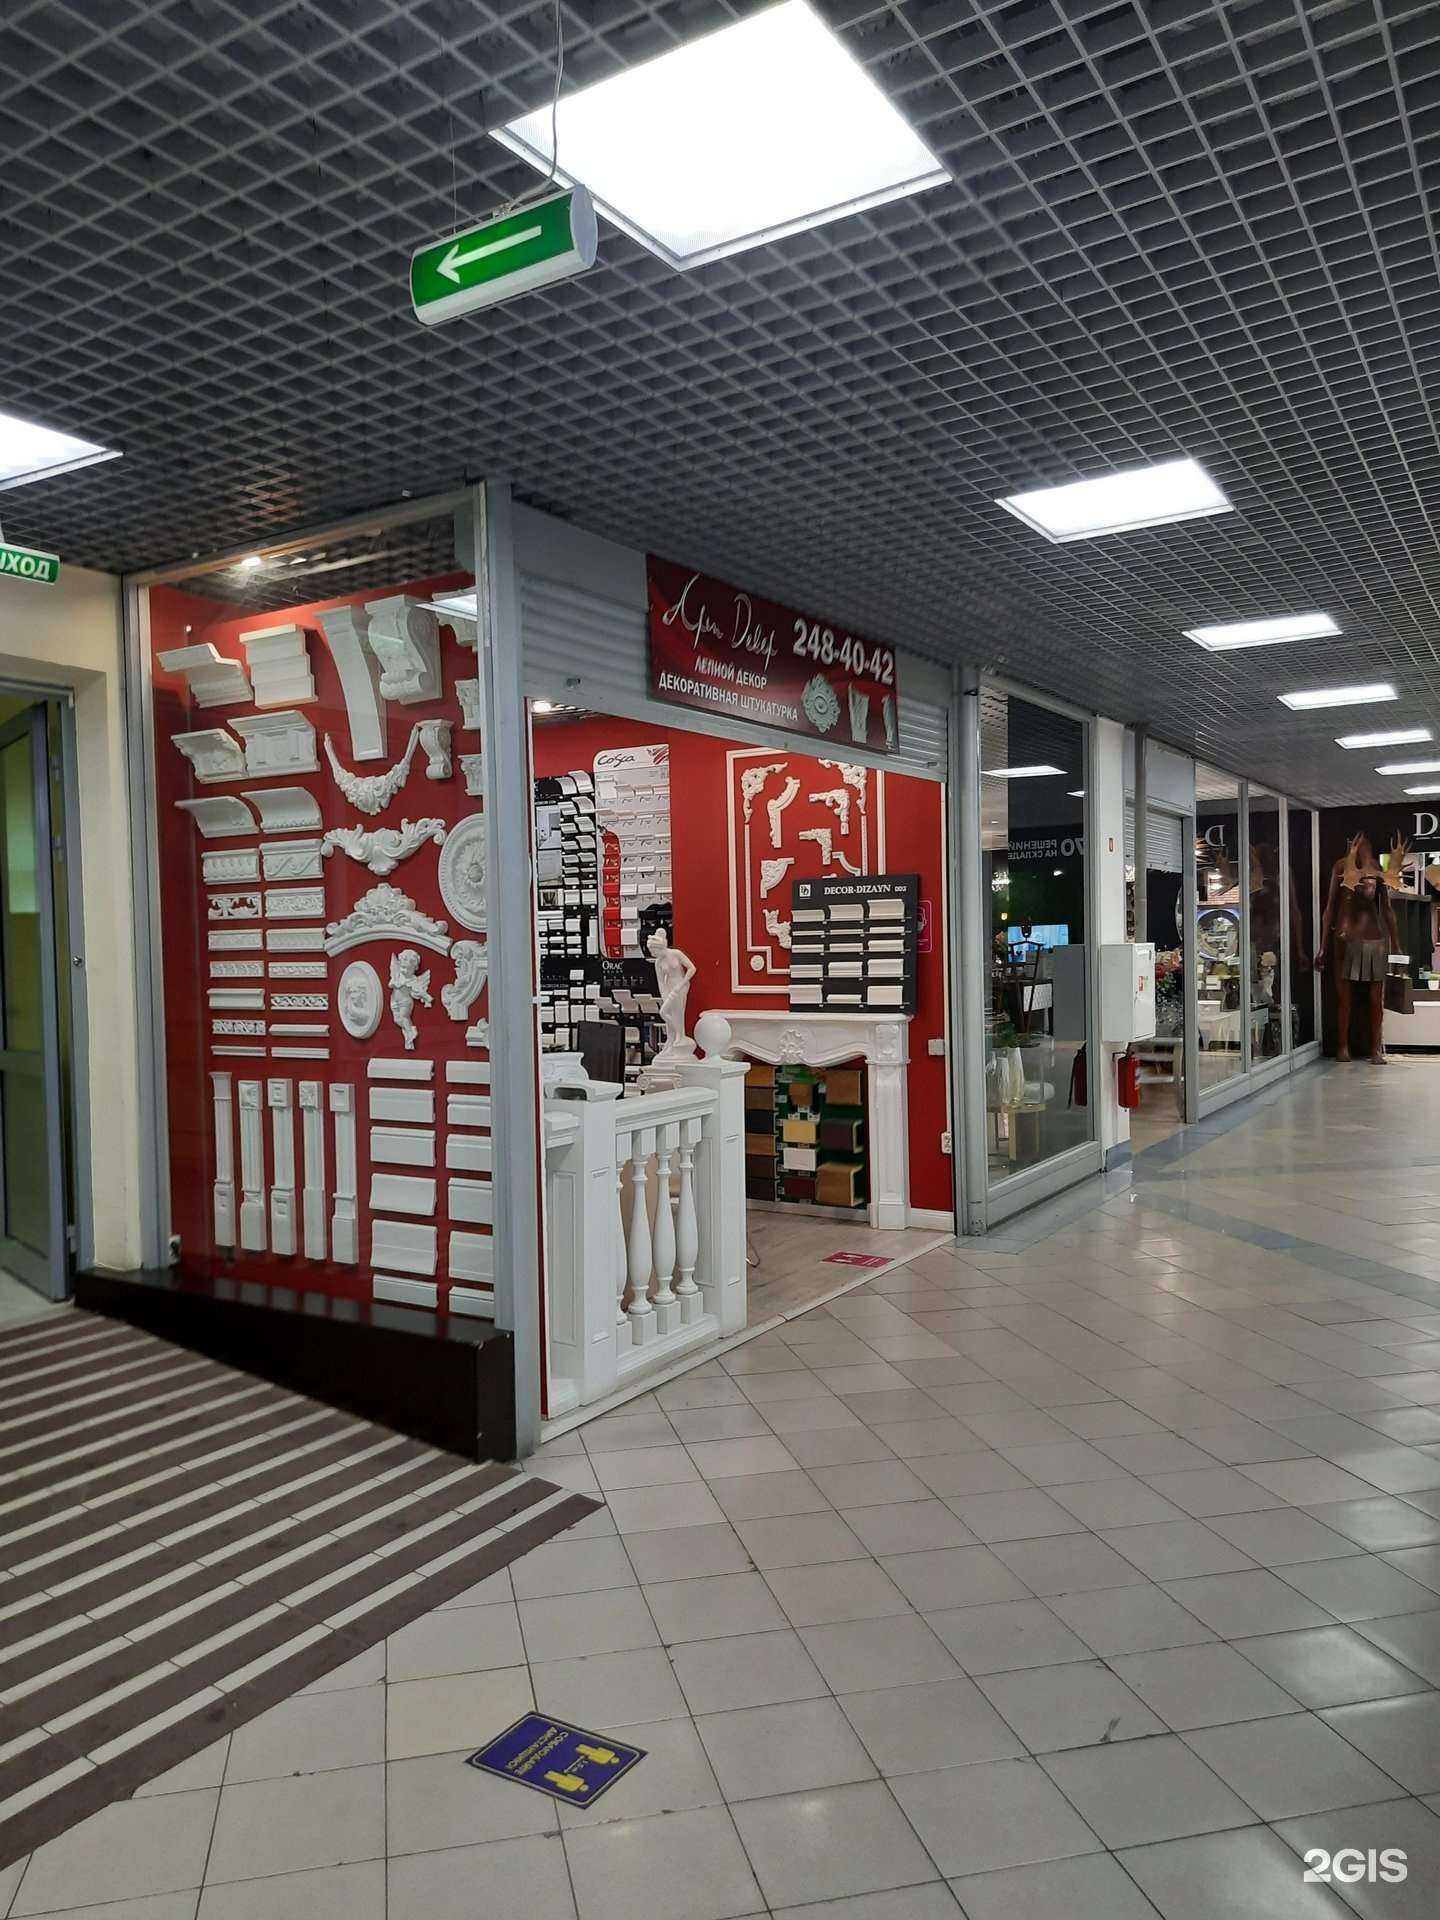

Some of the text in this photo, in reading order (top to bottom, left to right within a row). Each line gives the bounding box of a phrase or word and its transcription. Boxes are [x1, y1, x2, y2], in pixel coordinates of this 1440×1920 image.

[694, 655, 768, 690] ЛЕПНОЙ ДЕКОР
[793, 618, 895, 685] 248-40-42
[659, 671, 799, 721] ДЕКОРАТИВНАЯ ШТУКАТУРКА
[824, 884, 891, 895] DECOR-DIZAYN
